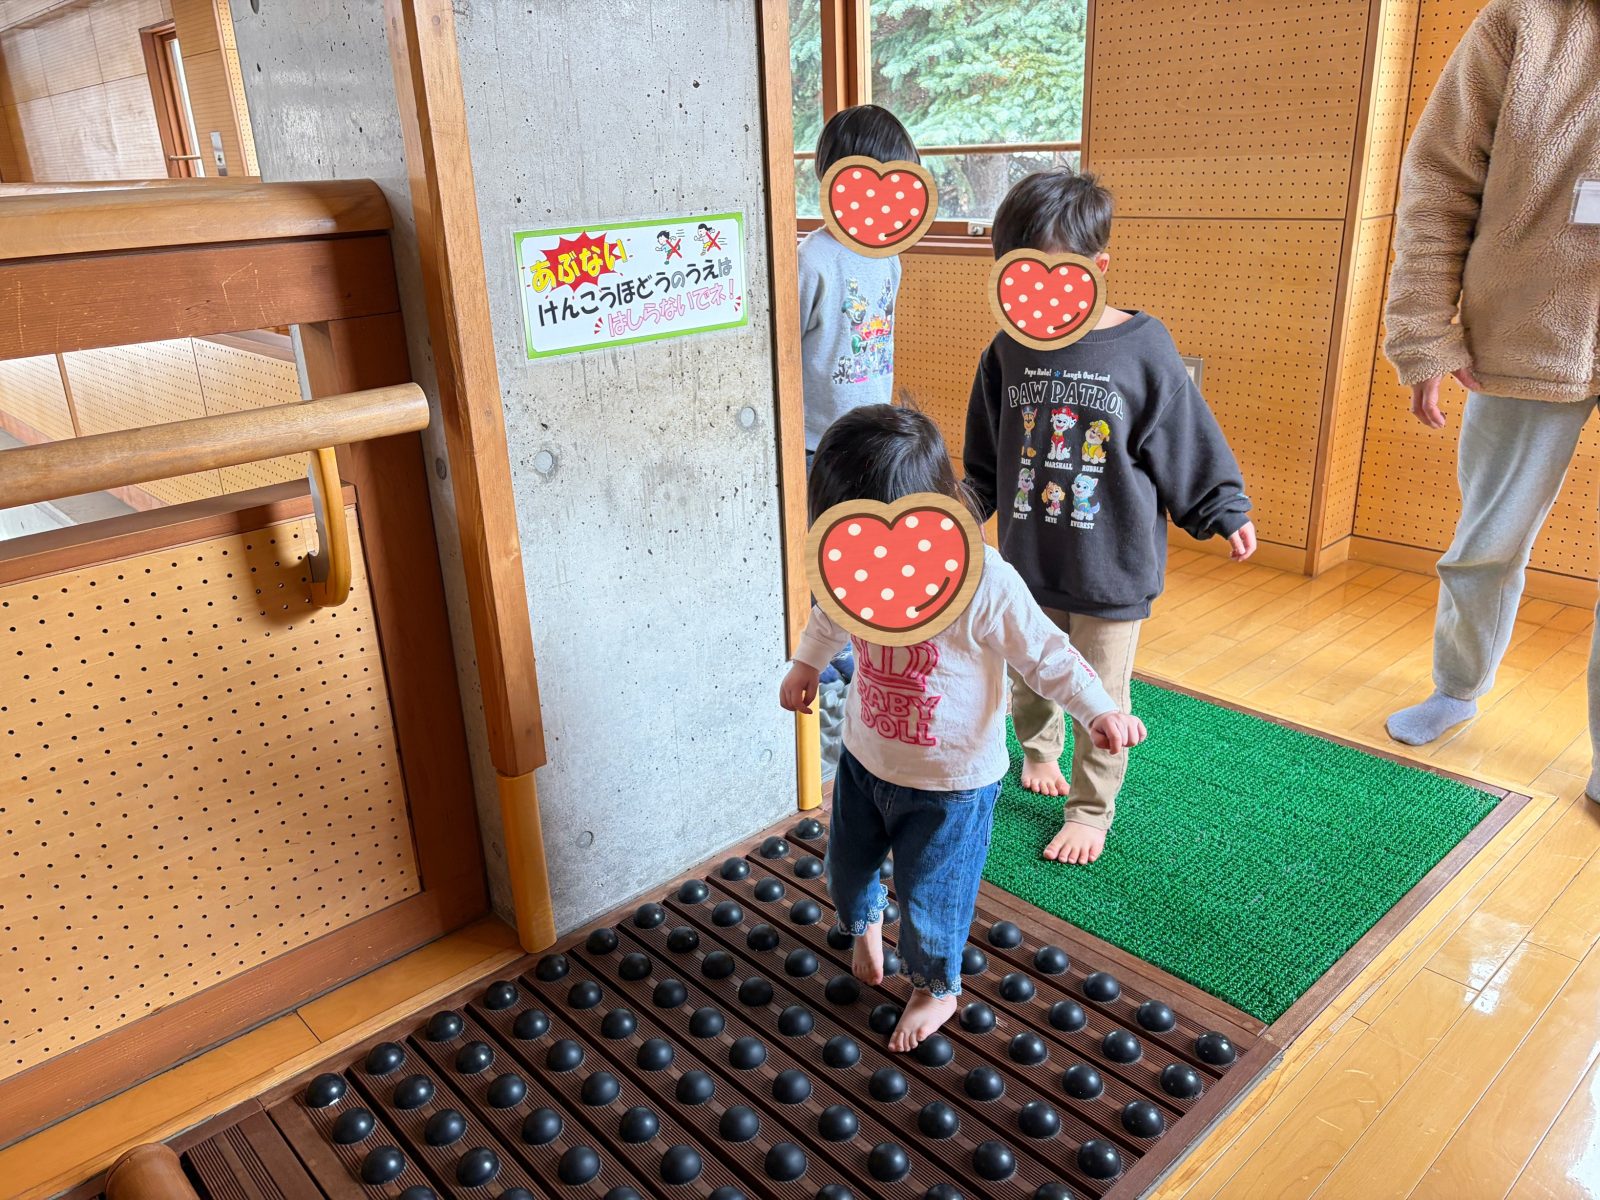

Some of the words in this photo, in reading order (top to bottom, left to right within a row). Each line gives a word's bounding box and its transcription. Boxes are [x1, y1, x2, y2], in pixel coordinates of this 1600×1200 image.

[530, 238, 628, 293] あぶない
[538, 256, 733, 327] けんこうほどうのうえは
[1063, 370, 1081, 380] Laugh
[1083, 371, 1094, 380] Out
[1095, 372, 1111, 382] Loud
[1008, 380, 1048, 408] PAW
[1051, 380, 1125, 420] PATROL
[1044, 460, 1073, 470] MARSHALL
[1044, 515, 1058, 524] SKYE
[1070, 520, 1095, 530] EVEREST
[861, 698, 937, 746] DOLL
